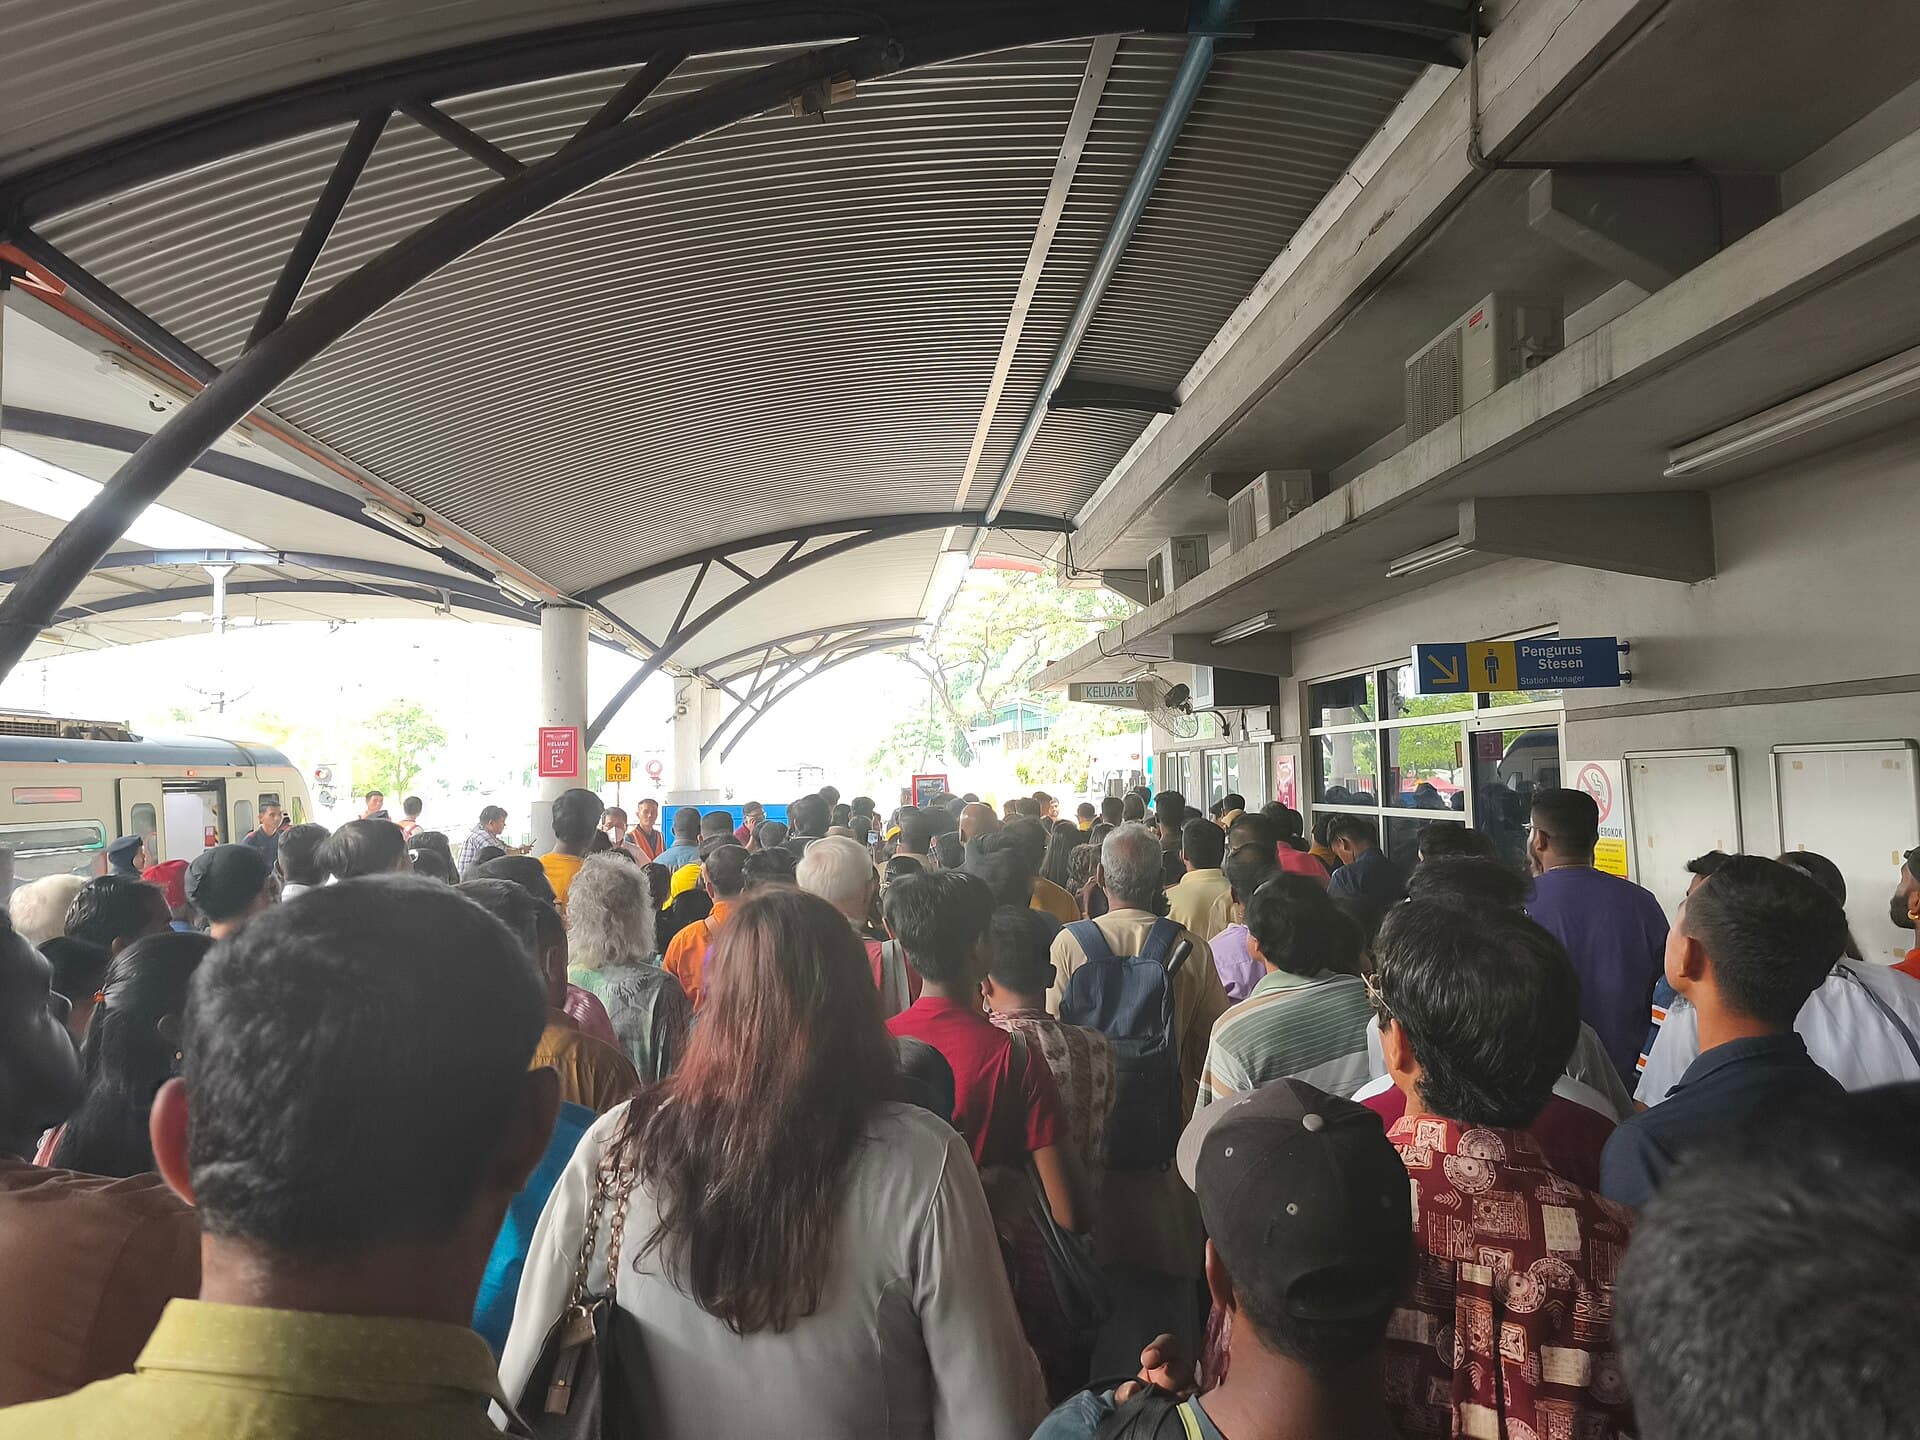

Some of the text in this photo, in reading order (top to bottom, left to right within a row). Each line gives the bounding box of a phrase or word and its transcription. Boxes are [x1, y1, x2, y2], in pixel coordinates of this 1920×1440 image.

[1521, 646, 1582, 658] Pengurus
[1538, 658, 1583, 670] Stesen
[1520, 675, 1584, 685] Station Manager
[1086, 686, 1124, 698] KELUAR
[615, 763, 621, 773] 6
[1598, 827, 1623, 838] EROKOK
